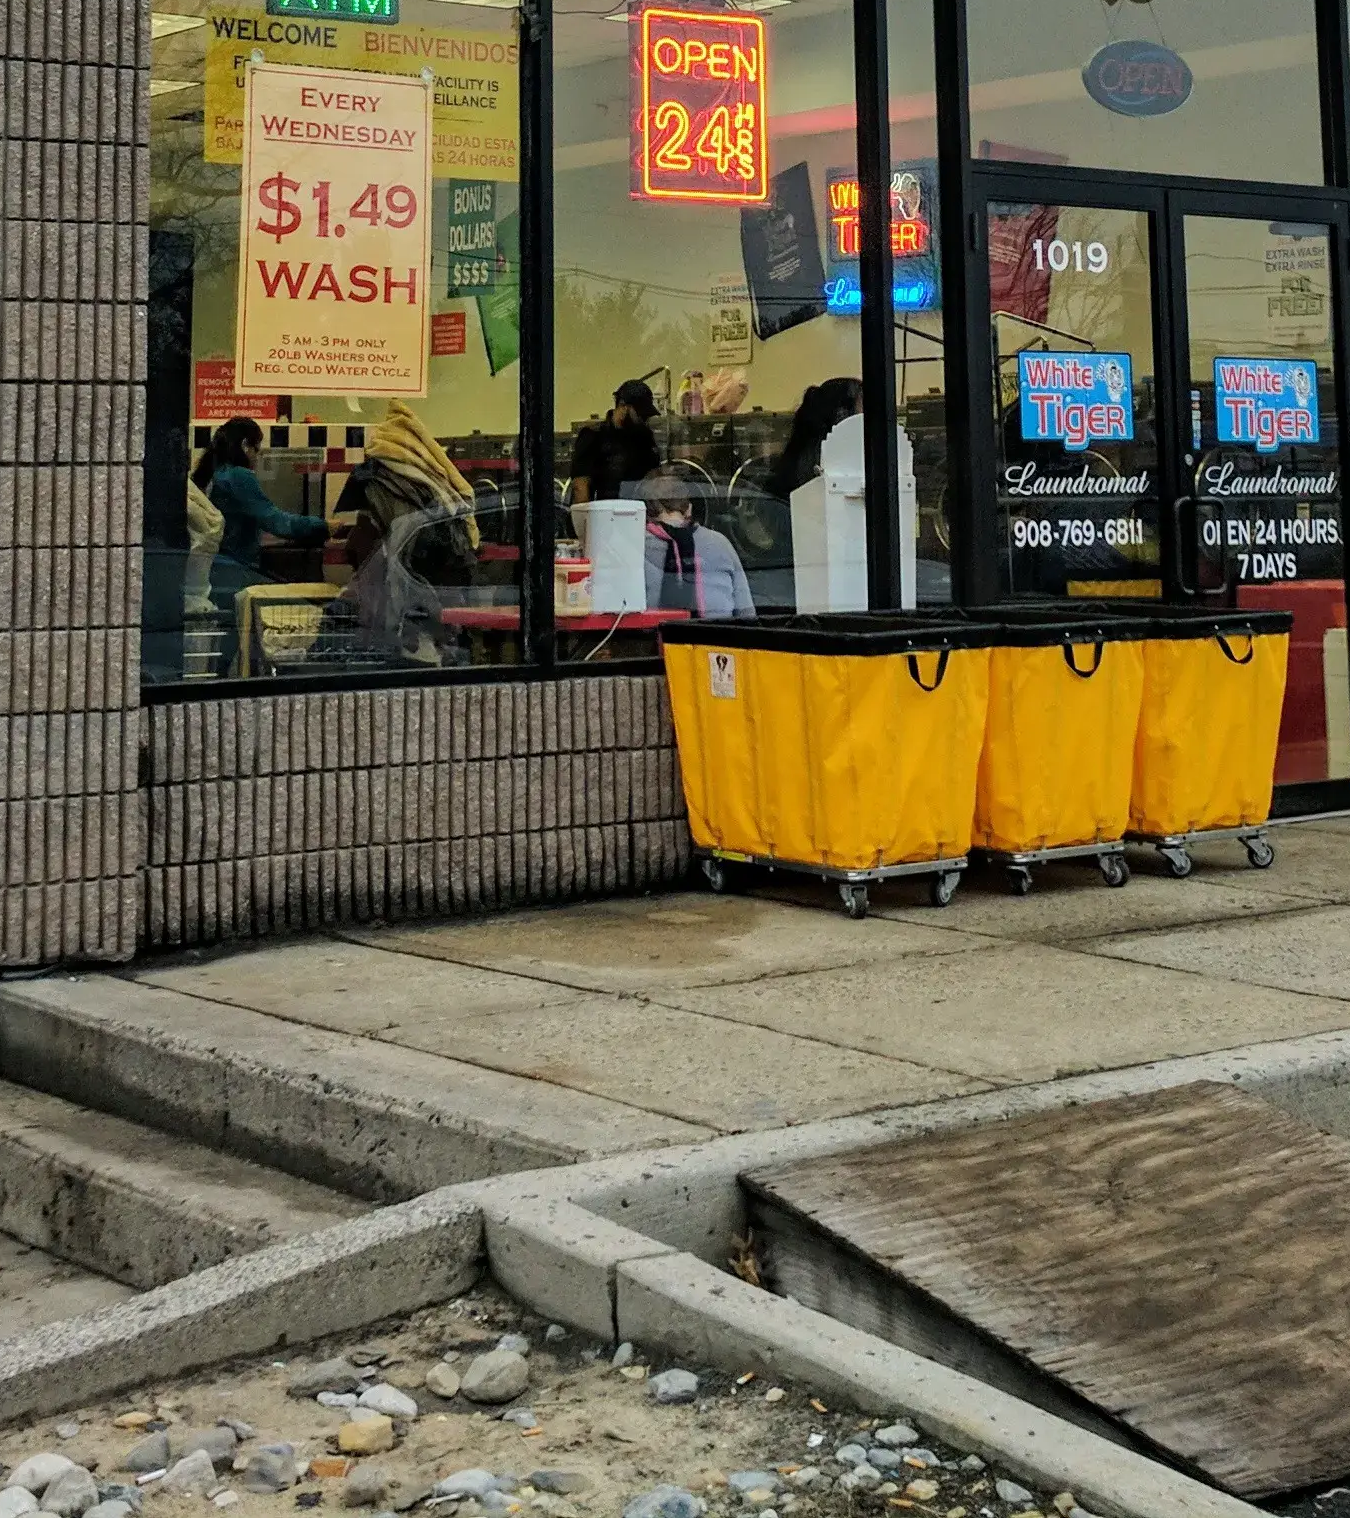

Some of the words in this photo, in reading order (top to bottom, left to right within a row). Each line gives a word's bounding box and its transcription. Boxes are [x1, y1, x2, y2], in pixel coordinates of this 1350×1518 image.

[212, 16, 338, 49] WELCOME
[364, 30, 519, 65] BIENVENIDOS
[652, 36, 758, 83] OPEN
[488, 80, 499, 92] IS
[300, 88, 382, 113] EVERY
[434, 93, 497, 109] EILLANCE
[215, 116, 243, 132] PAR
[261, 114, 418, 148] WEDNESDAY
[654, 101, 734, 173] 24
[216, 136, 243, 150] BAJ
[433, 134, 480, 148] CILIDAD
[485, 138, 516, 150] ESTA
[448, 150, 466, 165] 24
[470, 154, 516, 168] HORAS
[255, 171, 418, 245] $1.49
[454, 185, 492, 215] BONUS
[832, 217, 917, 254] TiER
[1033, 238, 1109, 272] 1019
[1266, 248, 1295, 260] EXTRA
[1296, 246, 1325, 256] WASH
[1265, 262, 1295, 273] EXTRA
[256, 259, 418, 305] WASH
[282, 334, 291, 345] 5
[294, 336, 311, 346] AM
[321, 336, 329, 346] 3
[332, 338, 349, 347] PM
[355, 339, 386, 348] ONLY
[288, 363, 322, 375] COLD
[325, 365, 369, 376] WATER
[305, 350, 365, 362] WASHERS
[368, 354, 398, 363] ONLY
[1026, 359, 1093, 390] White
[1221, 365, 1282, 394] White
[1005, 461, 1150, 496] Laundromat
[1205, 461, 1337, 496] Laundromat
[1014, 518, 1143, 548] 908-769-6811
[1255, 519, 1277, 545] 24
[1280, 518, 1339, 544] HOURS
[1237, 554, 1250, 579] 7
[1252, 552, 1297, 578] DAYS
